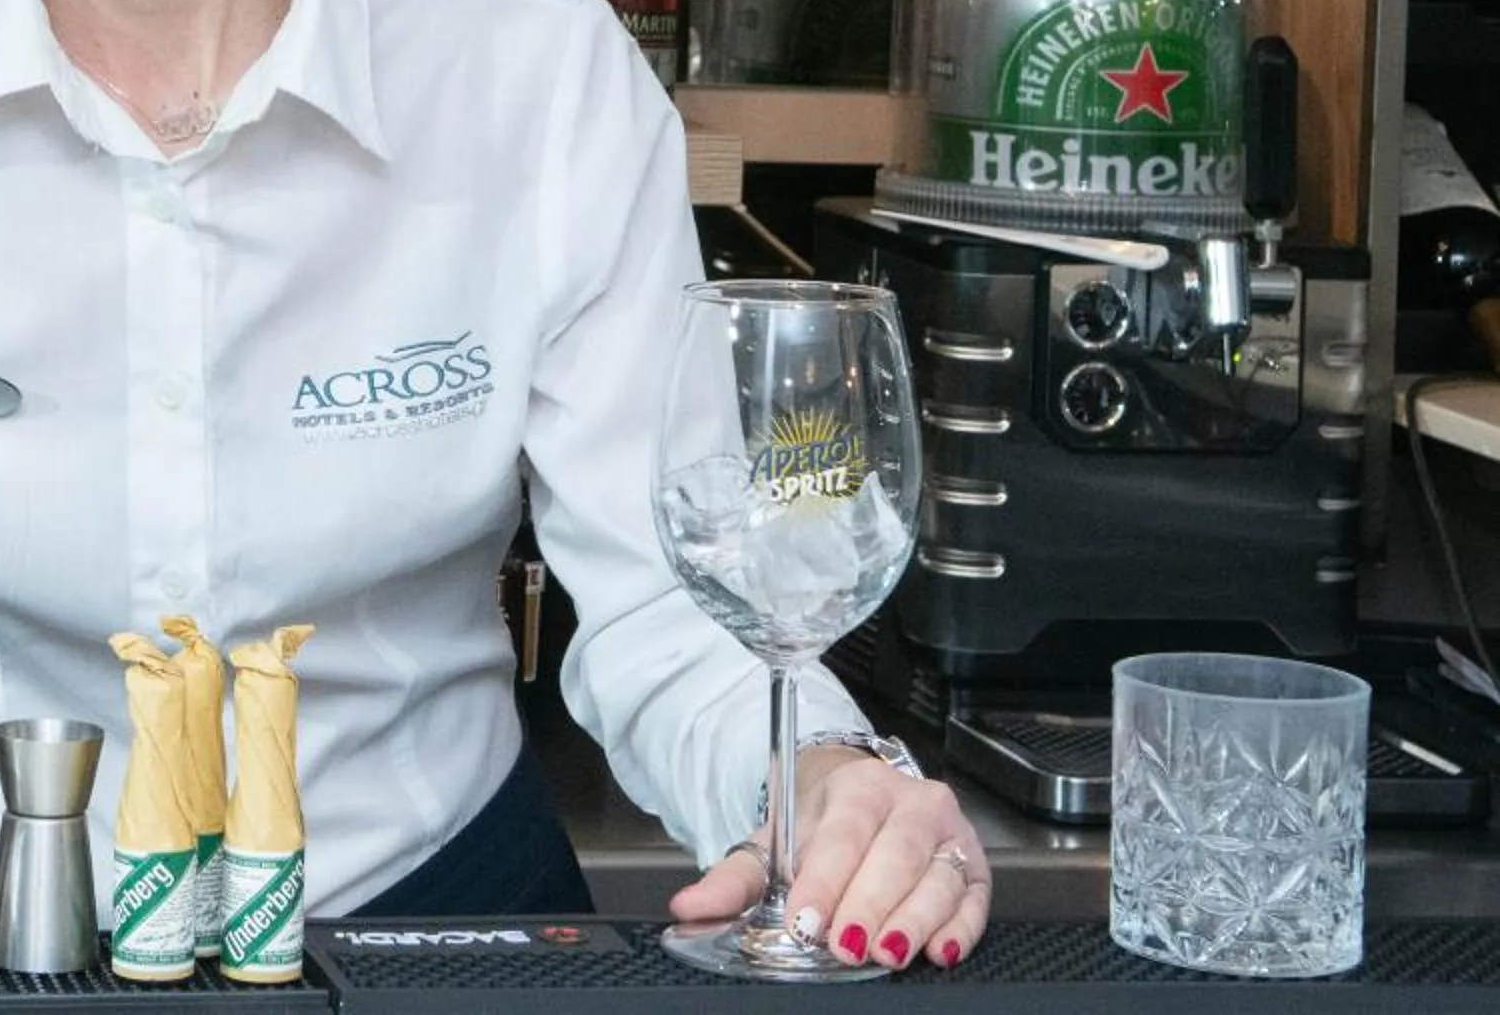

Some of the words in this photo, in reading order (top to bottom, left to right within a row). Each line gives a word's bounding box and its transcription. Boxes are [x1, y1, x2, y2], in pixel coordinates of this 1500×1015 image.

[1016, 1, 1141, 107] HEINEKEN
[969, 131, 1246, 198] Heineke
[292, 345, 492, 410] ACROSS
[292, 410, 377, 428] HOTELS
[769, 466, 849, 502] SPRITZ
